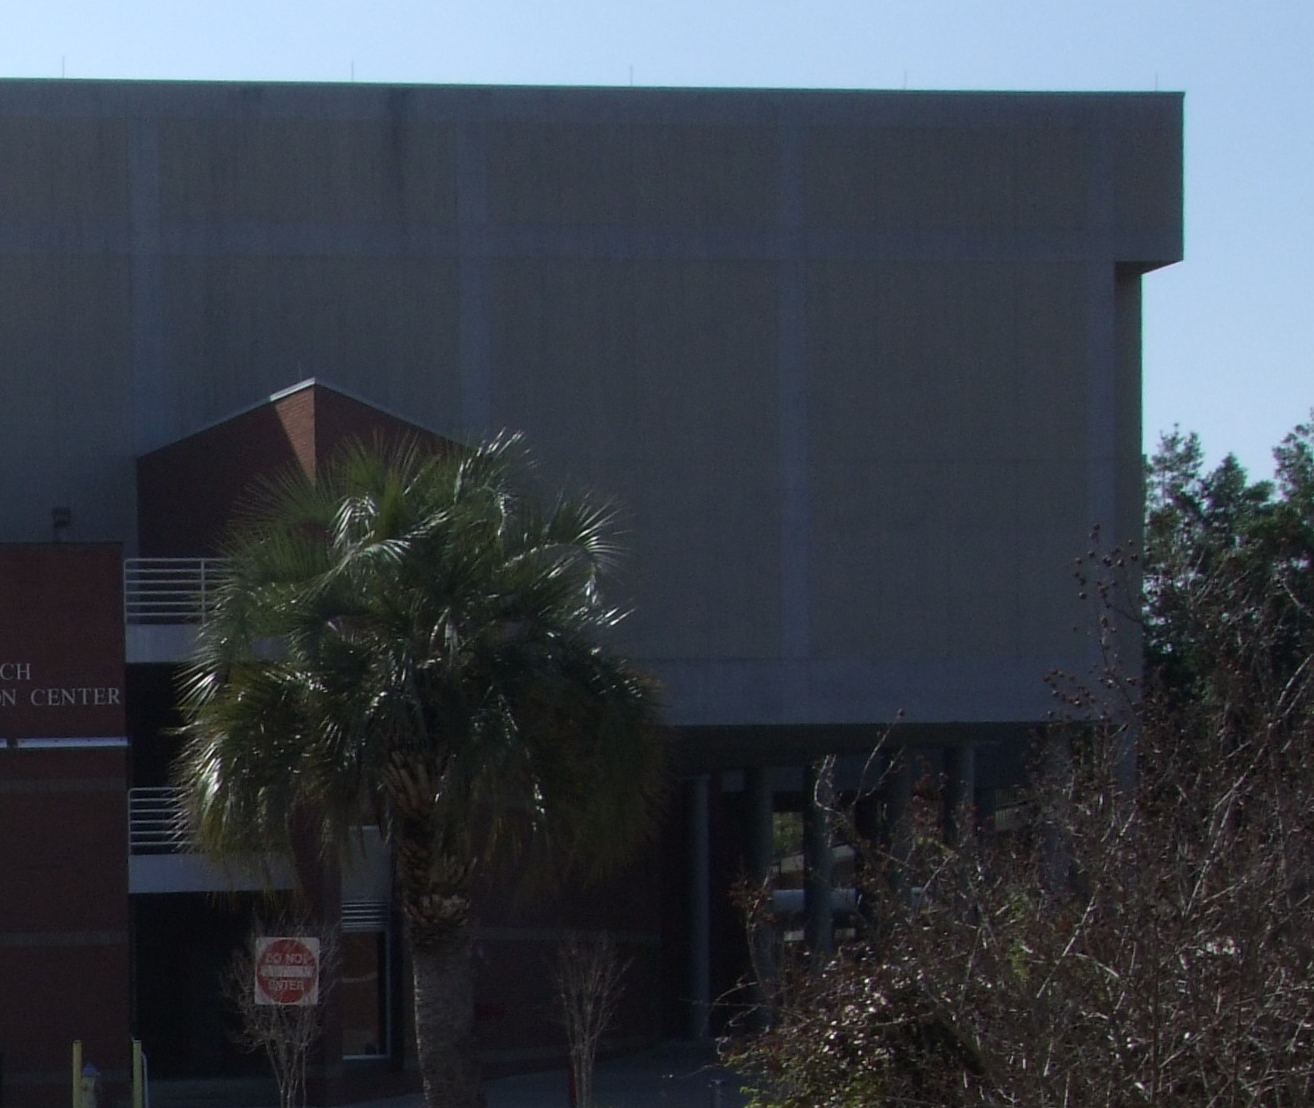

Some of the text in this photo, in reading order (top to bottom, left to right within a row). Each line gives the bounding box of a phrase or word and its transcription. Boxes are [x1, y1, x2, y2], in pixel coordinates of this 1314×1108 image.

[30, 686, 121, 706] CENTER
[265, 952, 307, 963] DO NOT
[269, 979, 305, 990] ENTER
